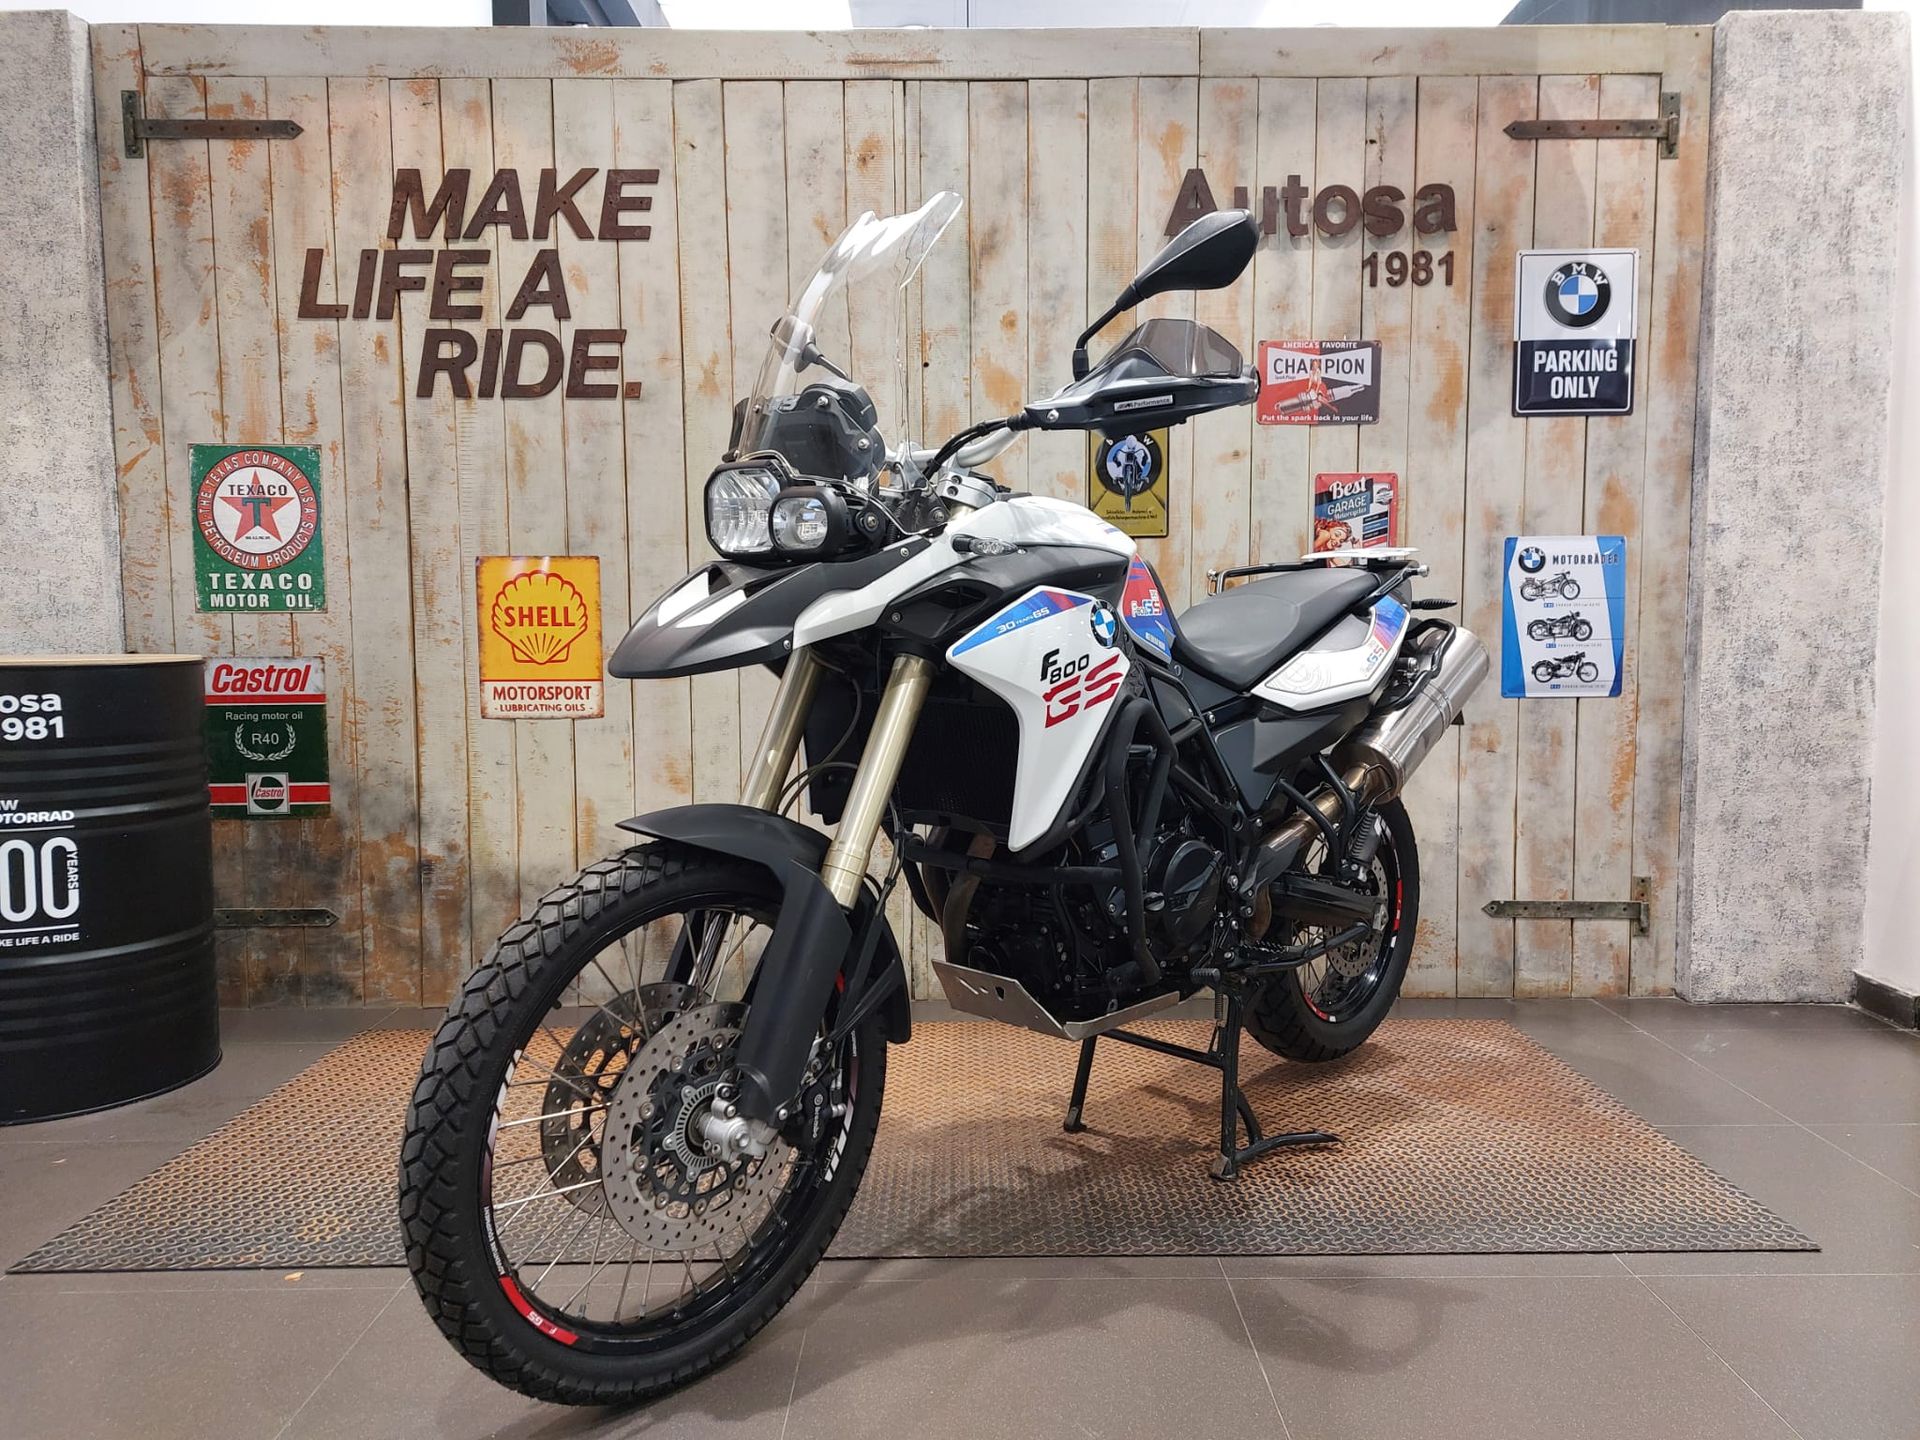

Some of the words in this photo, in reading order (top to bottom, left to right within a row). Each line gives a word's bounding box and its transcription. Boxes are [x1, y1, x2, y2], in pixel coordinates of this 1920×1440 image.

[387, 168, 660, 240] MAKE
[1362, 250, 1454, 288] 1981
[1551, 263, 1609, 286] BMW
[298, 249, 491, 319] LIFE
[505, 249, 571, 319] A
[416, 329, 642, 398] RIDE.
[1534, 350, 1618, 373] PARKING
[1550, 376, 1600, 398] ONLY
[1106, 435, 1154, 446] BW
[206, 456, 240, 488] TEXAS
[244, 452, 301, 481] COMPANY
[228, 484, 288, 496] TEXACO
[1329, 476, 1367, 500] Best
[200, 490, 213, 514] THE
[1327, 495, 1367, 515] GARAGE
[201, 520, 259, 568] PETROLEUM
[266, 520, 315, 567] PRODUCTS
[209, 573, 313, 590] TEXACO
[210, 594, 270, 608] MOTOR
[286, 594, 314, 608] OIL
[504, 606, 576, 627] SHELL
[996, 621, 1016, 634] 30
[1033, 607, 1050, 619] GS
[1040, 648, 1060, 681] F
[1050, 654, 1090, 684] 800
[212, 664, 311, 693] Castrol
[493, 686, 592, 701] MOTORSPORT
[1042, 653, 1123, 728] GS
[225, 711, 259, 722] Racing
[261, 712, 289, 720] motor
[292, 711, 303, 720] oil
[500, 703, 562, 712] LUBRICATING
[564, 703, 586, 711] OILS
[1, 716, 64, 741] 981
[252, 733, 280, 745] R40
[255, 787, 285, 798] Castrol
[0, 799, 19, 811] W
[66, 850, 79, 890] YEARS
[16, 936, 40, 946] LIFE
[41, 935, 51, 944] A
[53, 932, 80, 943] RIDE
